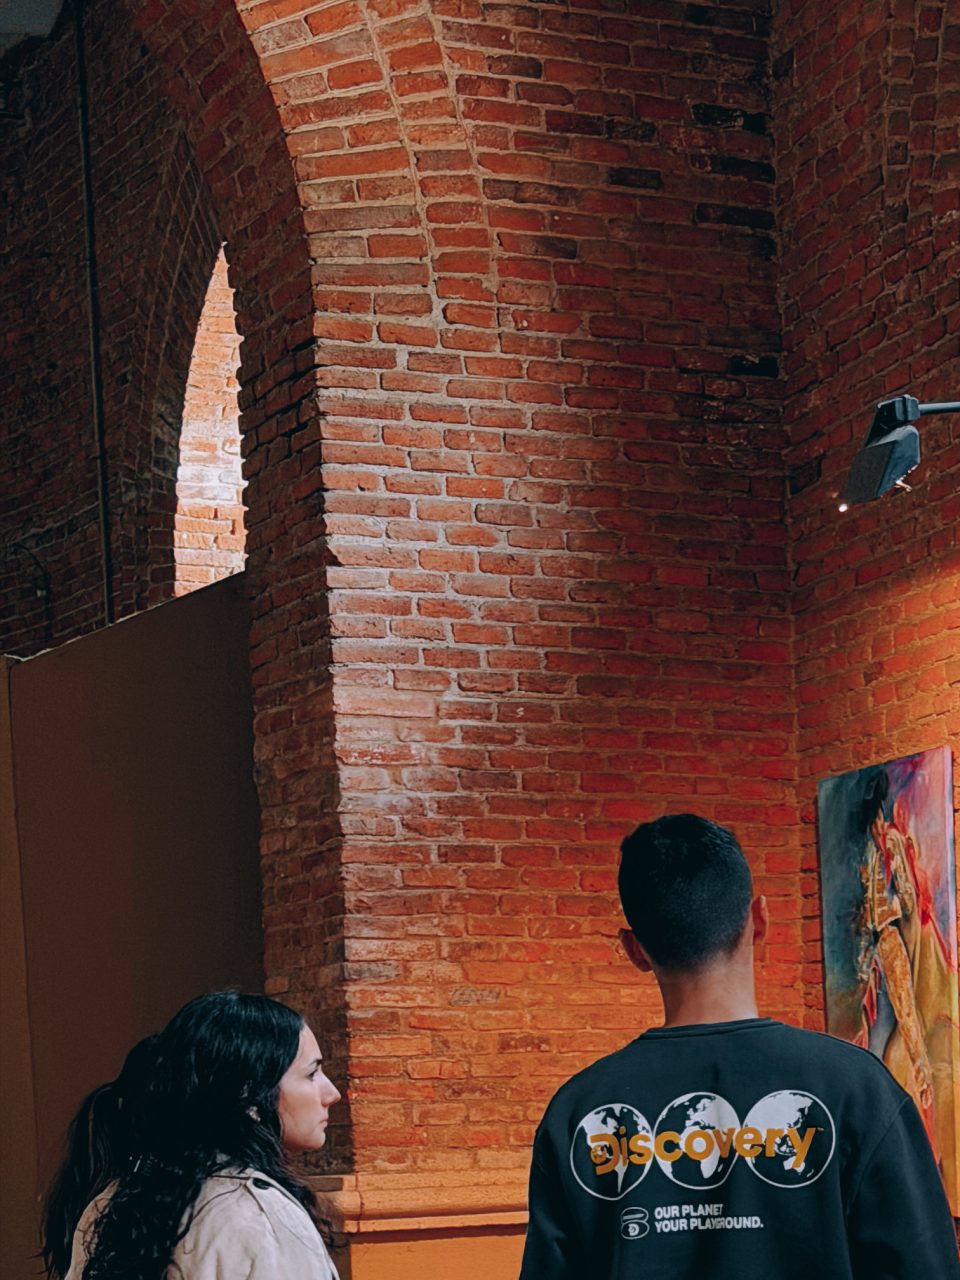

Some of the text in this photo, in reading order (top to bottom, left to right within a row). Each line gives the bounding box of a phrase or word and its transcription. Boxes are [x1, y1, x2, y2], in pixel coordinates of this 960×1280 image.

[654, 1203, 724, 1220] OUR PLANET
[654, 1215, 764, 1233] YOUR PLAYGROUND.
